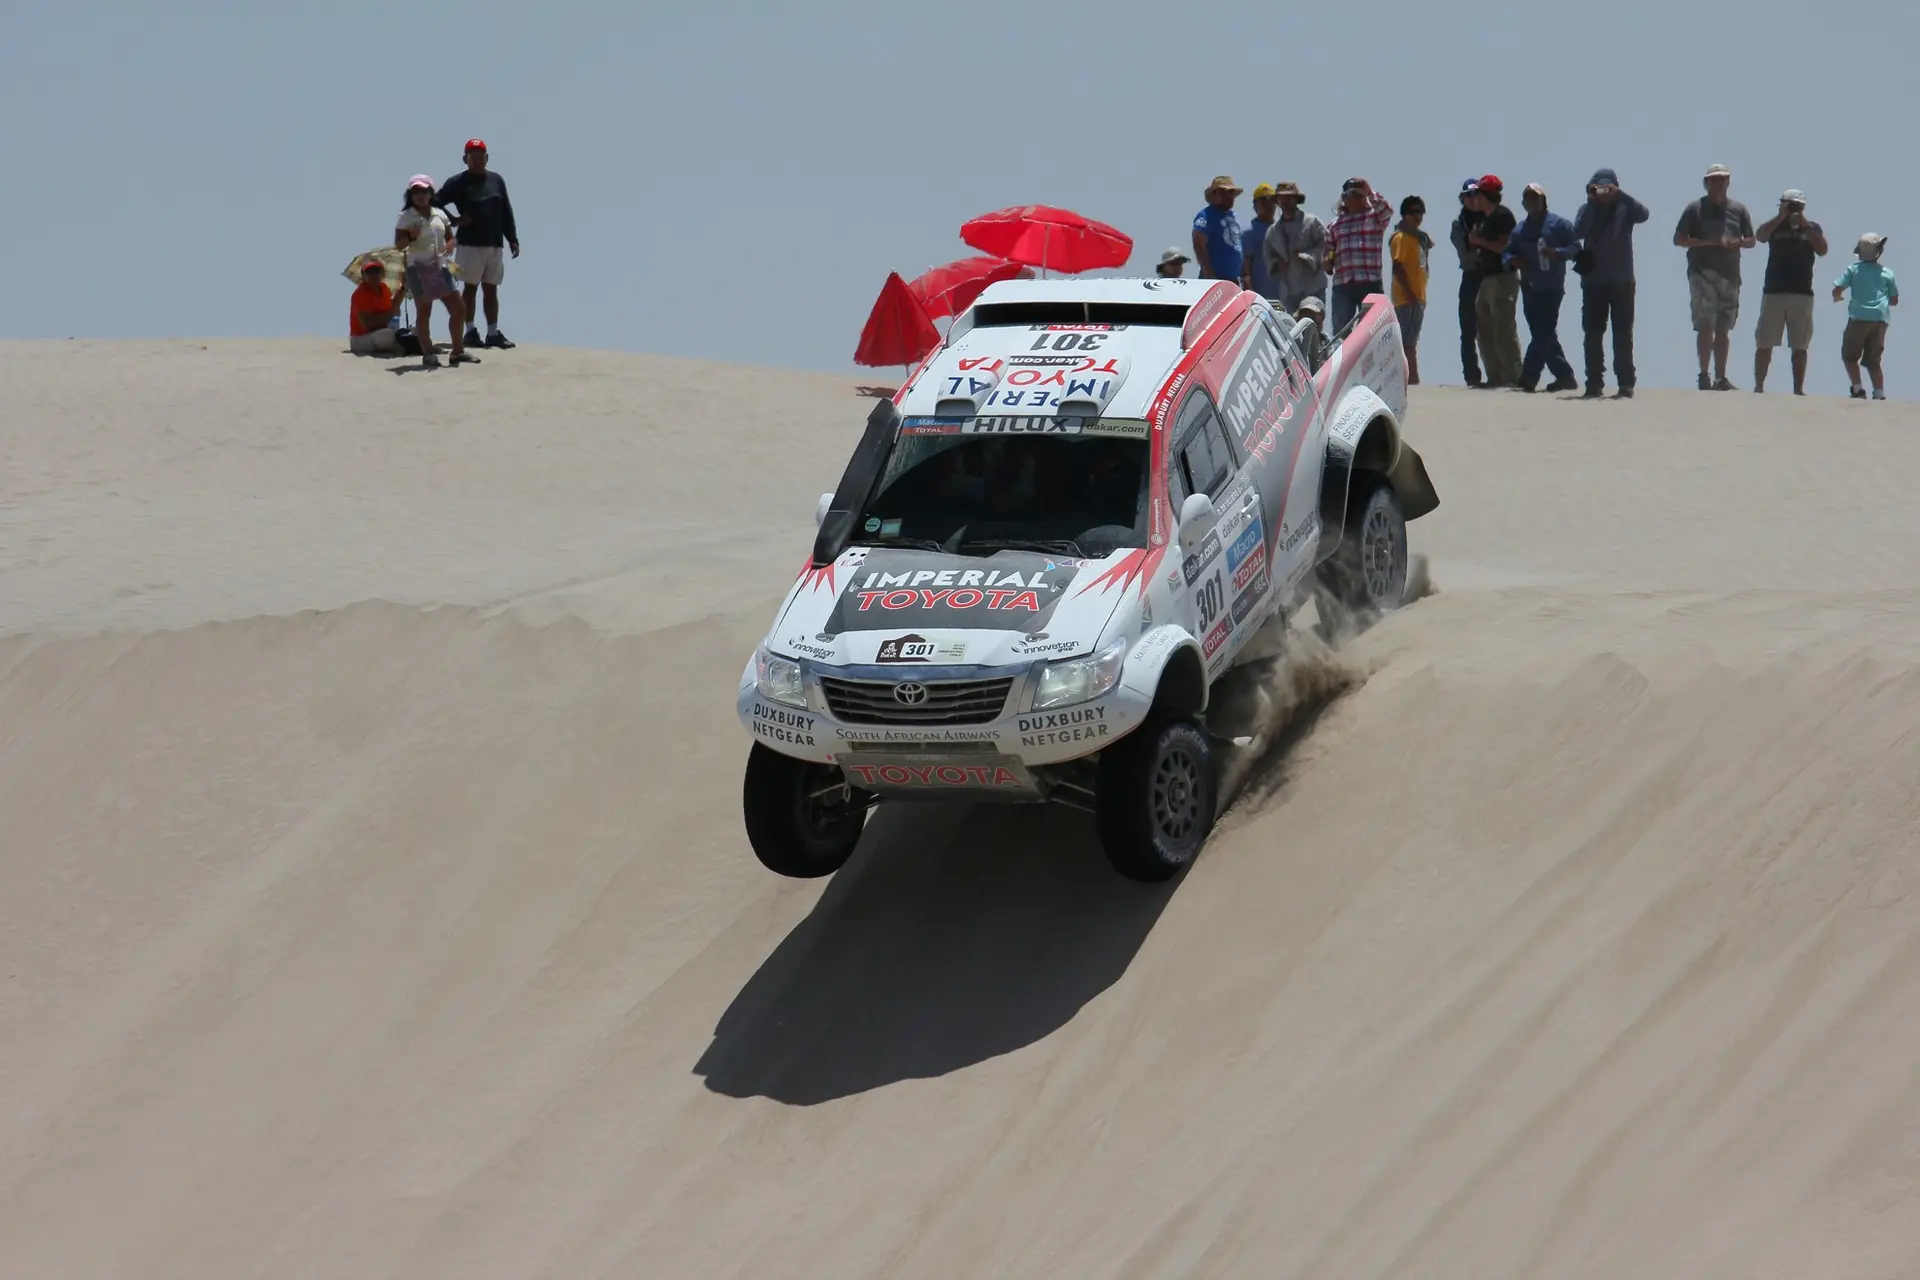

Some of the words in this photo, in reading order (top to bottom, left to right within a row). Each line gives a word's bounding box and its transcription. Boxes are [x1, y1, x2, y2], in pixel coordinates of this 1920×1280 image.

[1029, 333, 1109, 351] 301
[1009, 356, 1082, 365] akar.com
[1227, 326, 1292, 437] IMPERIAL
[1155, 398, 1171, 431] DUXBURY
[1166, 372, 1186, 399] NETGEAR
[1243, 355, 1314, 466] TOYOTA
[973, 417, 1068, 433] HILUX
[1086, 422, 1145, 434] dakar.com
[1333, 404, 1361, 433] FINANCIAL
[1342, 412, 1368, 440] SERVICES
[1185, 538, 1220, 579] dakar.com
[1232, 530, 1256, 563] Macro
[862, 570, 1049, 589] IMPERIAL
[1238, 552, 1265, 585] TOTAL
[857, 588, 1040, 611] TOYOTA
[1196, 568, 1224, 634] 301
[905, 644, 935, 656] 301
[1023, 640, 1079, 654] innovation
[1204, 627, 1227, 654] TOTAL
[753, 703, 815, 731] DUXBURY
[1018, 705, 1106, 732] DUXBURY
[753, 720, 816, 747] NETGEAR
[836, 728, 881, 740] SOUTH
[884, 730, 941, 741] AFRICAN
[943, 730, 1001, 741] AIRWAYS
[1021, 724, 1109, 747] NETGEAR
[850, 764, 1023, 786] TOYOTA
